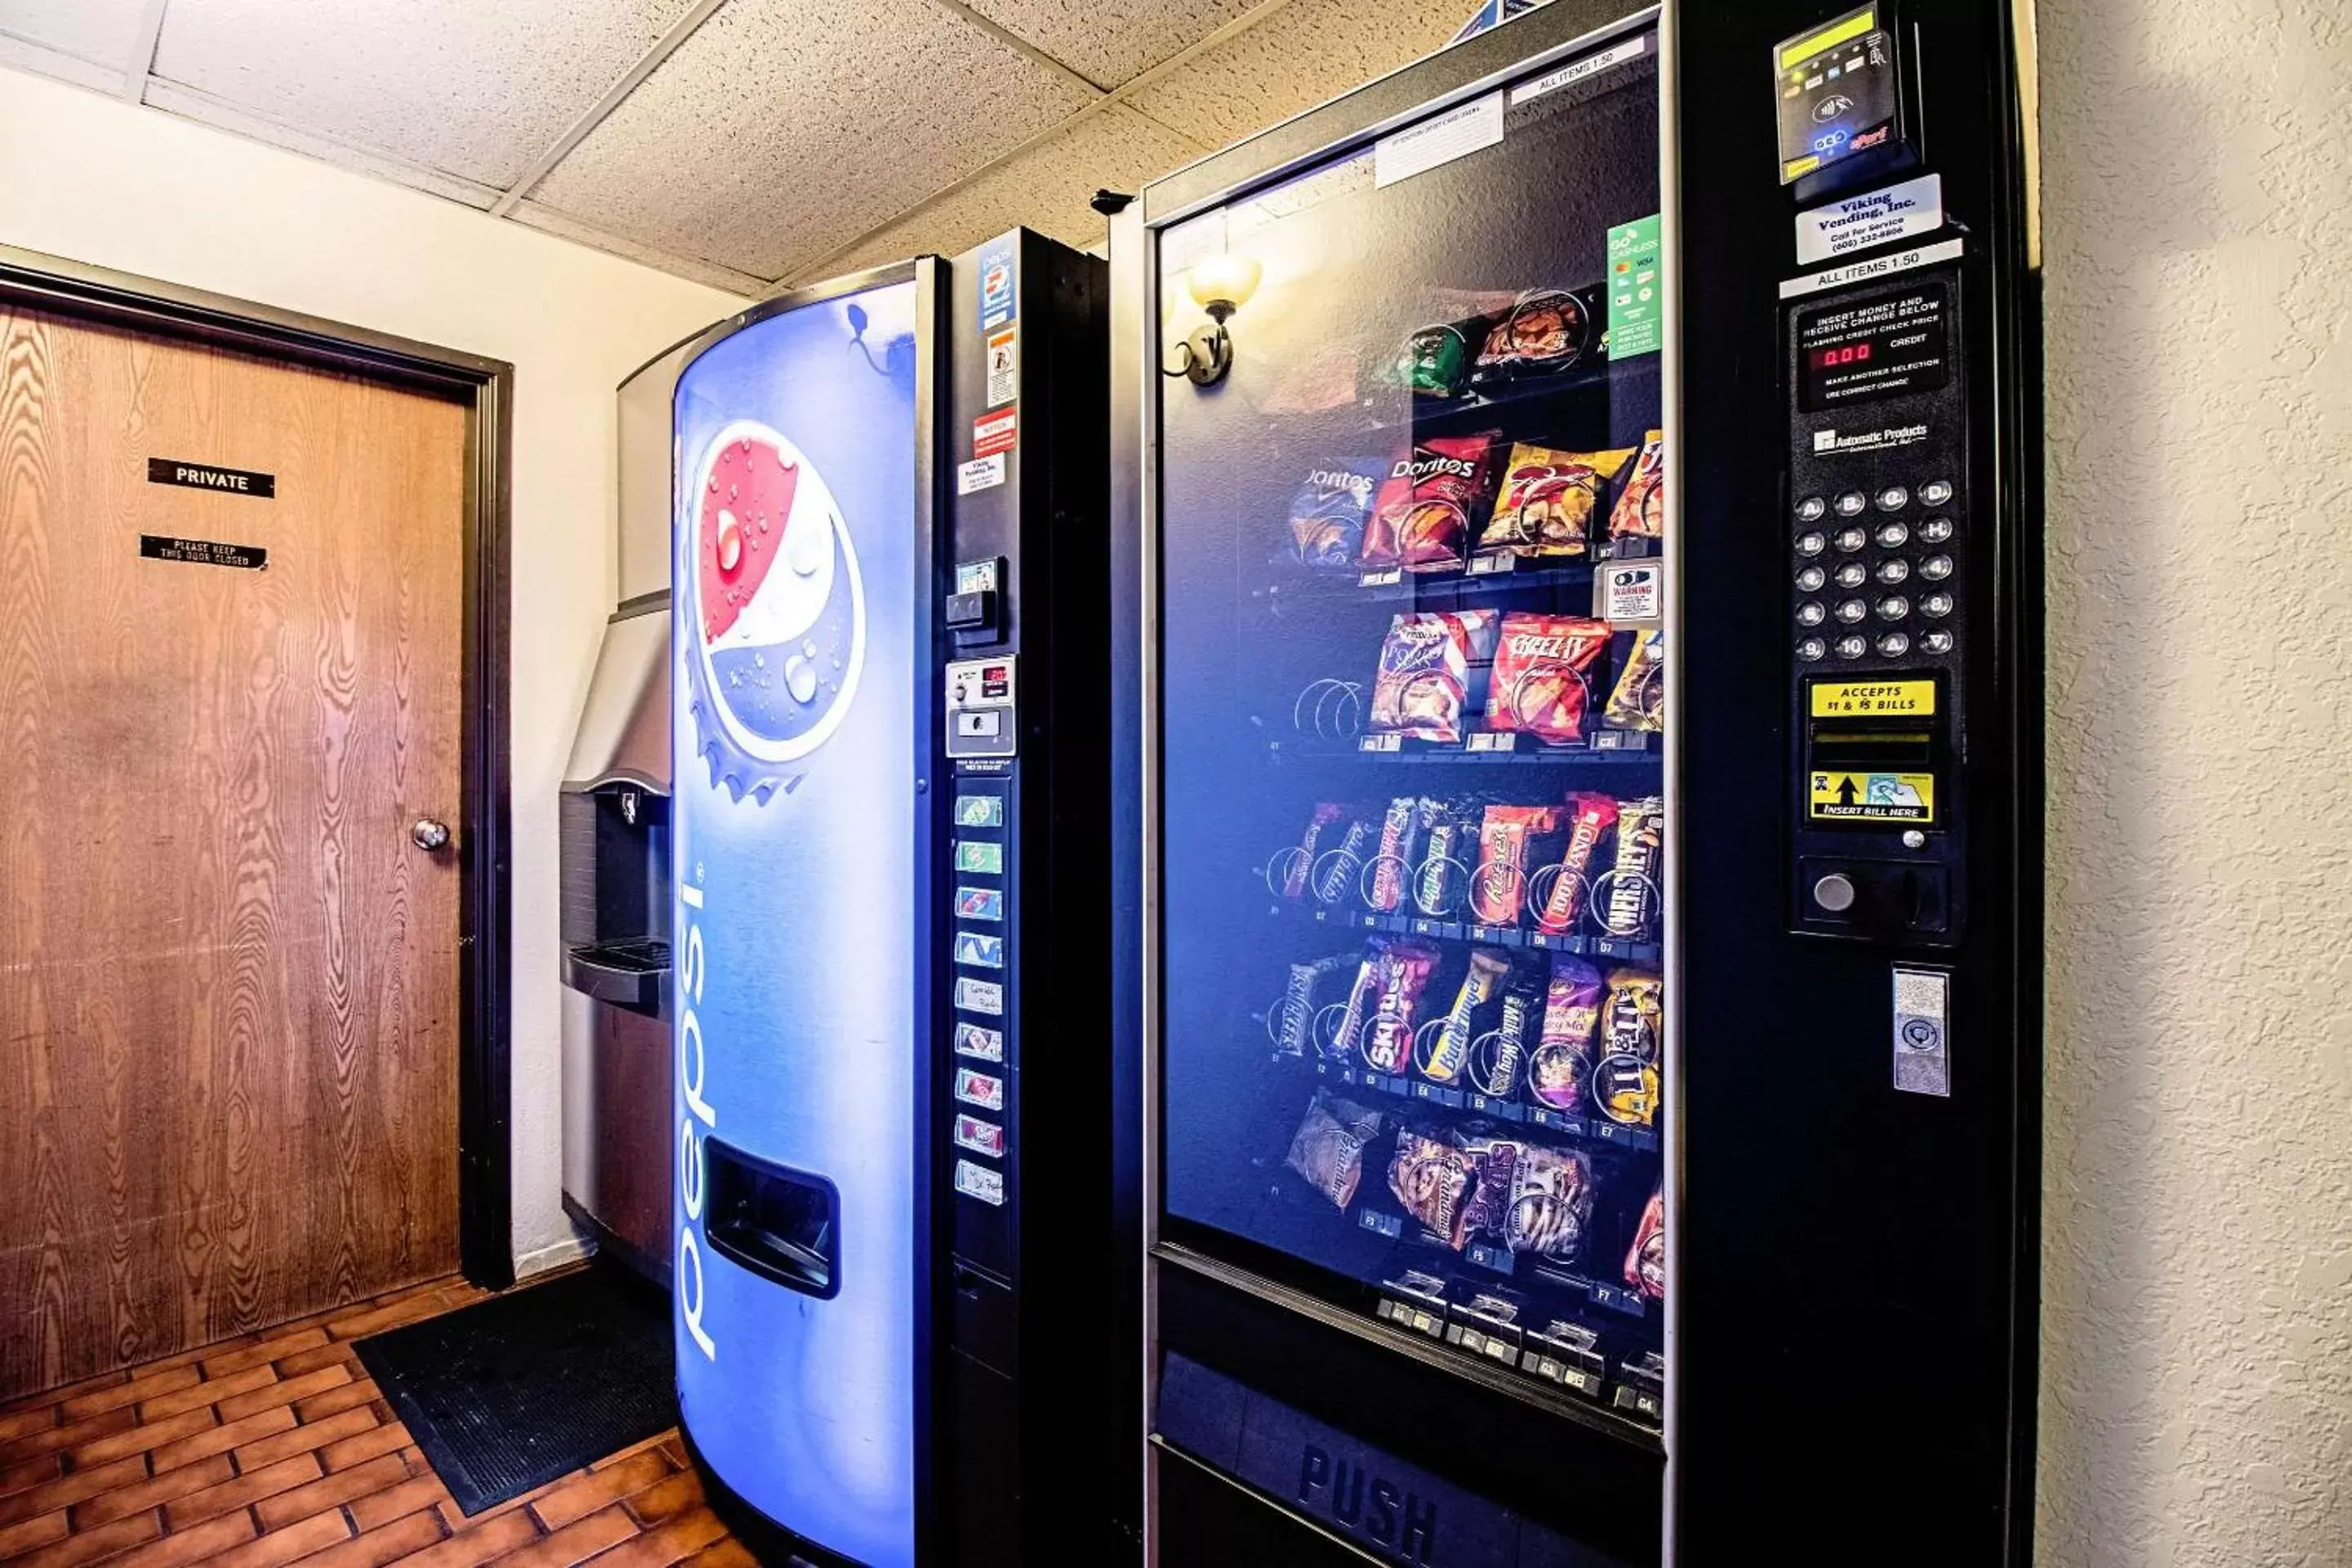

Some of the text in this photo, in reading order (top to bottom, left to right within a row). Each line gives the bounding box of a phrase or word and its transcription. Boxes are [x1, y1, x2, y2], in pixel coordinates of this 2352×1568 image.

[1559, 62, 1591, 81] ITEMS
[1593, 53, 1614, 68] 1.50
[1841, 193, 1891, 213] Viking
[1819, 198, 1916, 231] Vending, Inc.
[1831, 231, 1850, 243] Call
[1869, 217, 1904, 231] Service
[1819, 252, 1920, 285] ALL ITEMS 1.50
[1803, 301, 1939, 336] RECEIVE CHANGE BELOW
[1817, 296, 1923, 327] INSERT MONEY AND
[1891, 333, 1927, 348] CREDIT
[1825, 359, 1940, 385] MAKE ANOTHER SELECTION
[1836, 424, 1927, 448] Automatic Products
[1392, 456, 1475, 479] Doritos
[176, 467, 248, 491] PRIVATE
[161, 548, 249, 565] THIS DOOR CLOSED
[174, 540, 236, 555] PLEASE KEEP
[1614, 585, 1651, 596] WARNING
[1844, 640, 1860, 652] 10
[1841, 686, 1901, 697] ACCEPTS
[1827, 701, 1838, 710] $1
[1843, 701, 1852, 710] &
[1878, 698, 1915, 710] BILLS
[1824, 804, 1919, 817] INSERT BILL HERE
[1600, 942, 1612, 953] D7
[679, 878, 716, 1362] pepsi
[1598, 1290, 1610, 1301] F7
[1637, 1397, 1653, 1410] G4
[1298, 1444, 1439, 1568] PUSH
